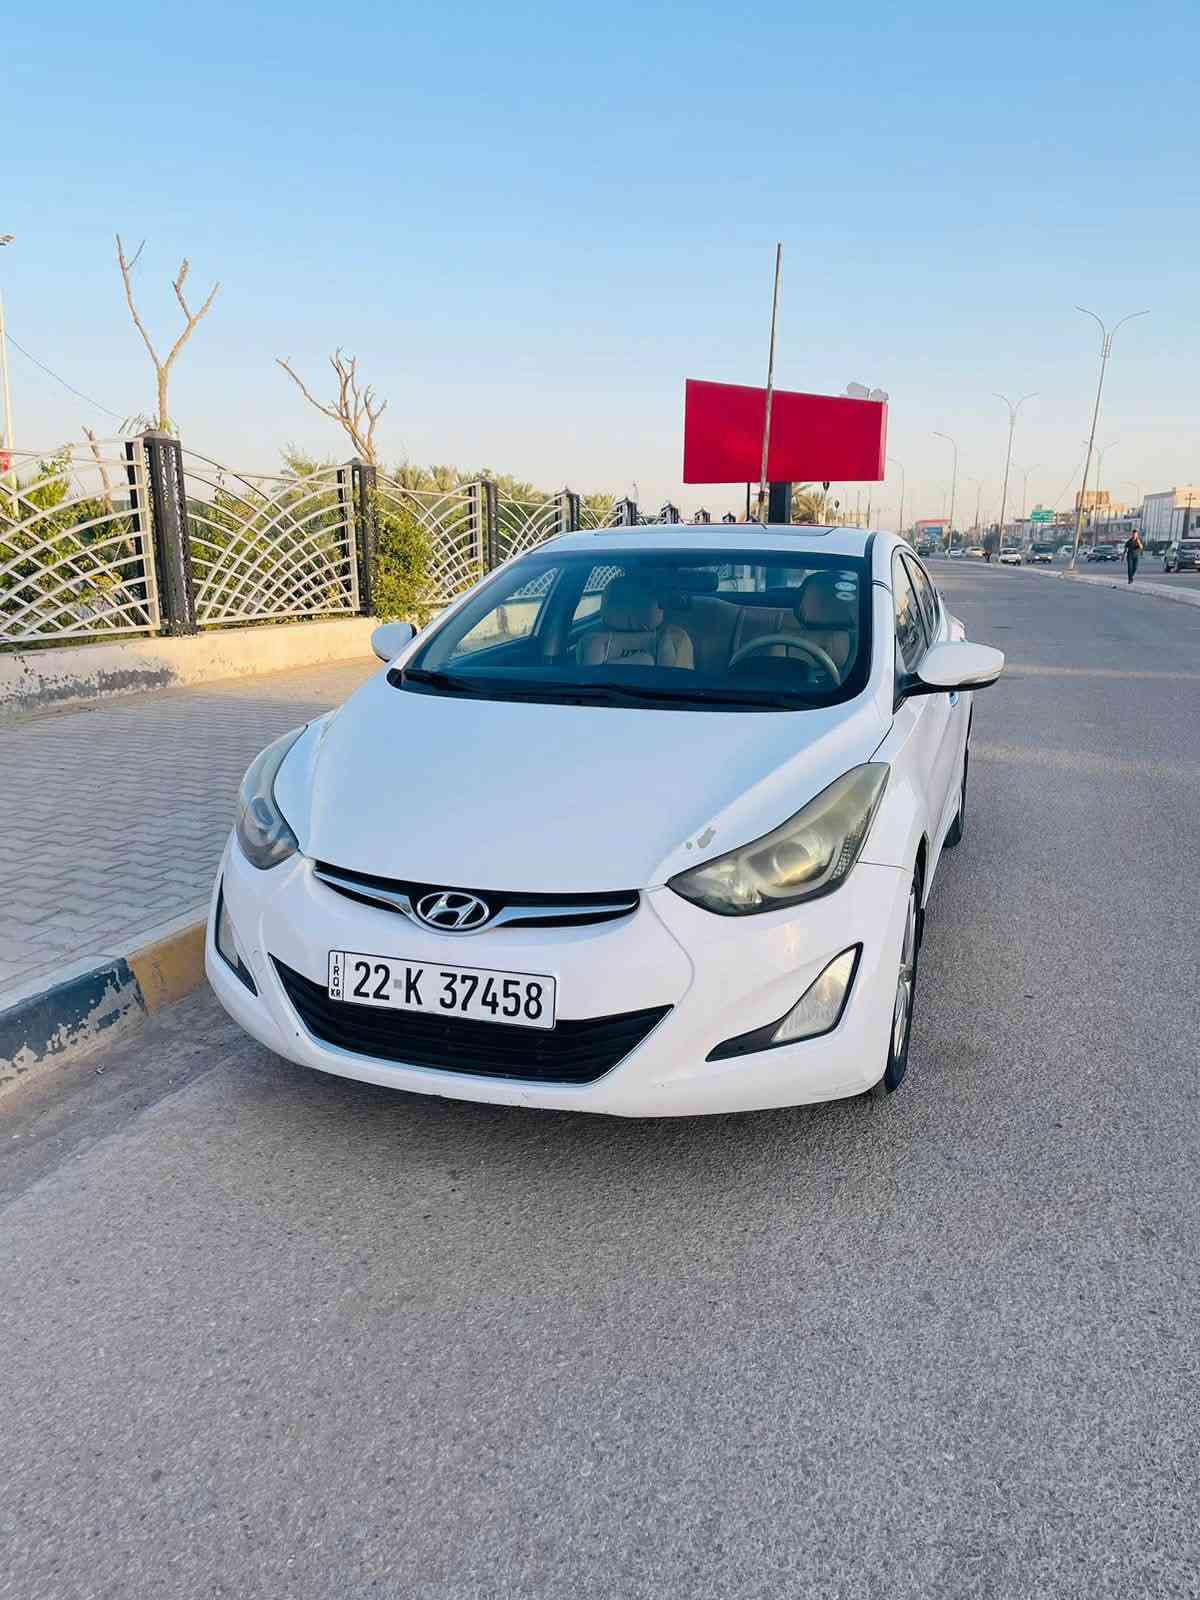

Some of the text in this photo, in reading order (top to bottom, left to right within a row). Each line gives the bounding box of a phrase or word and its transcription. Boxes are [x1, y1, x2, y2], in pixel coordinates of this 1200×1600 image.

[352, 961, 543, 1020] 22 K 37458
